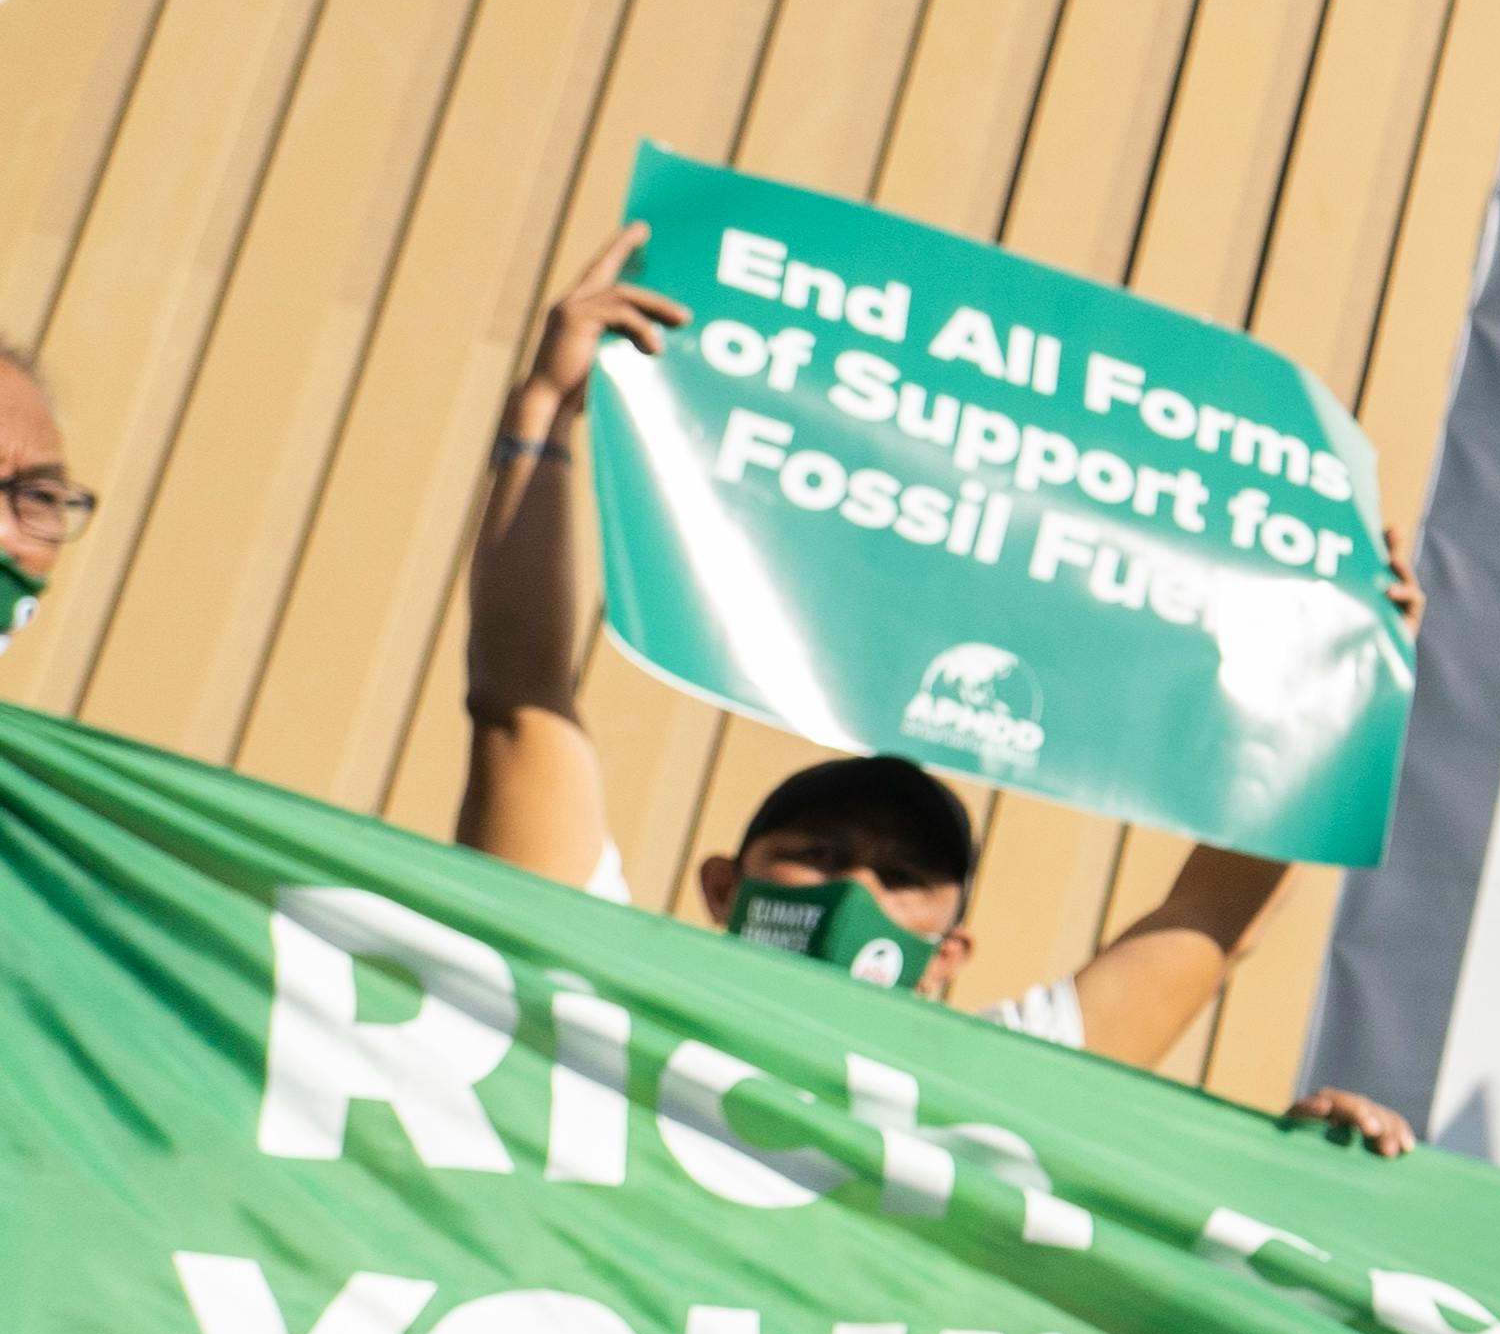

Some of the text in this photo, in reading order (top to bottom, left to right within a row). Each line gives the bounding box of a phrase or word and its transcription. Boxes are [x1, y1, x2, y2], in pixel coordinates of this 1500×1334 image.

[699, 317, 1355, 577] of Support for
[713, 407, 1013, 566] Fossil
[715, 227, 1355, 503] End All Forms
[256, 885, 1094, 1250] Rich
